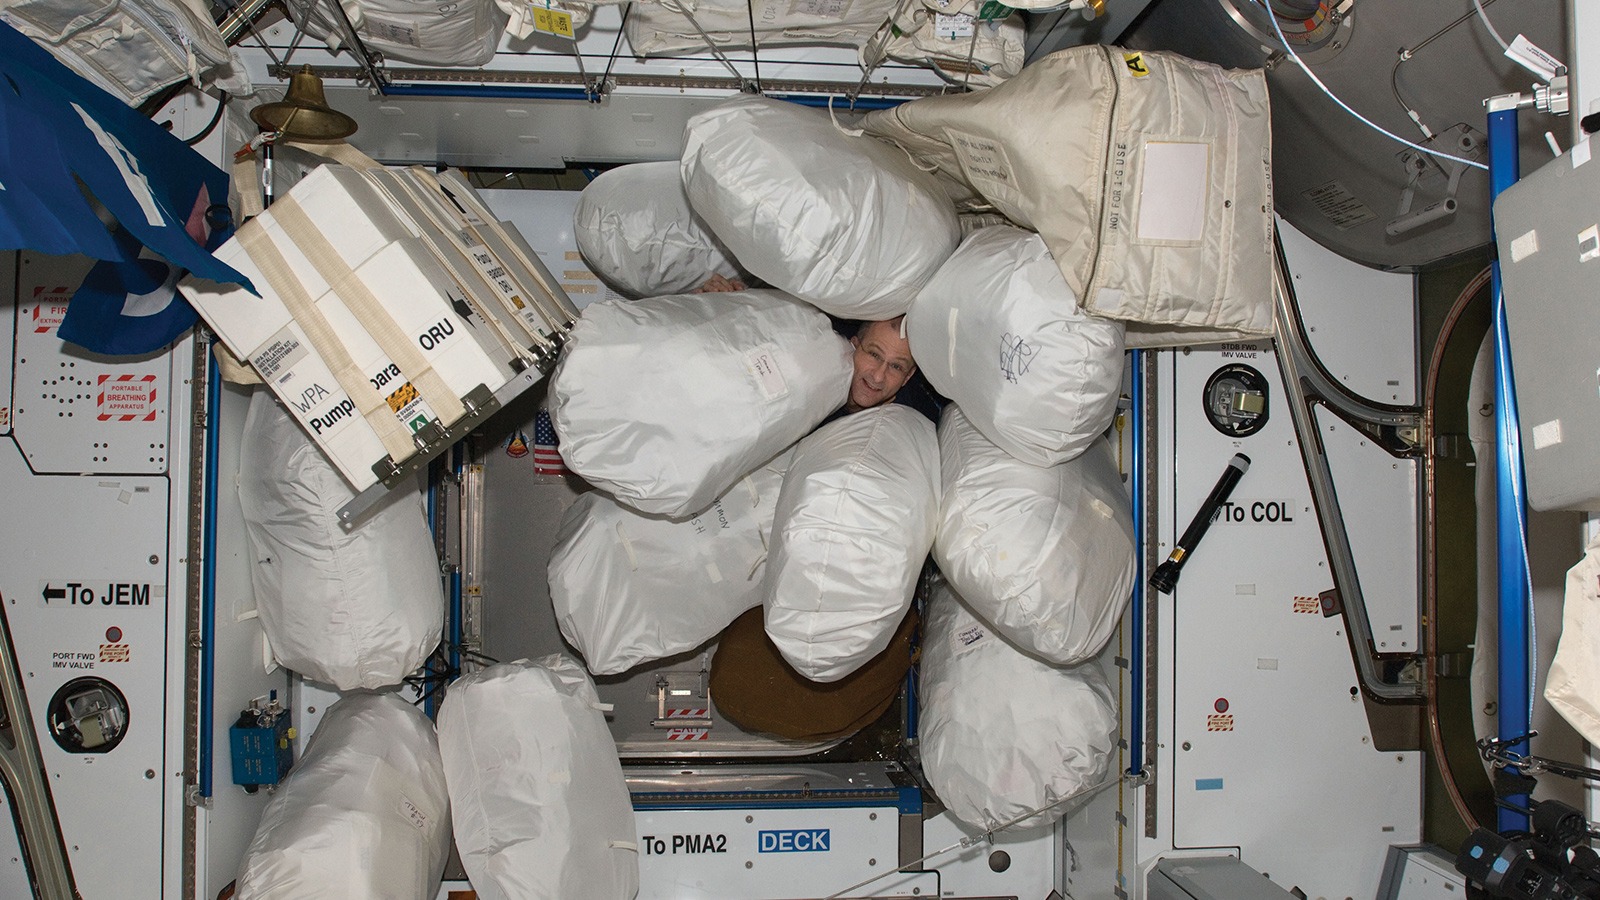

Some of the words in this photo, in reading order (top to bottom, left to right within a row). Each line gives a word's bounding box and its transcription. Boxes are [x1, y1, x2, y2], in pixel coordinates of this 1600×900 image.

[1126, 55, 1146, 73] A
[1116, 144, 1127, 166] USE
[1112, 188, 1121, 208] FOR
[1109, 210, 1119, 230] NOT
[418, 318, 455, 351] ORU
[257, 346, 285, 369] INSTALLATION
[291, 383, 330, 413] WPA
[1223, 502, 1245, 522] To
[1251, 501, 1293, 522] COL
[66, 583, 95, 605] To
[101, 583, 150, 606] JEM
[52, 652, 74, 660] PORT
[52, 661, 67, 669] IMV
[642, 836, 666, 855] To
[672, 834, 727, 854] PMA2
[761, 831, 828, 851] DECK
